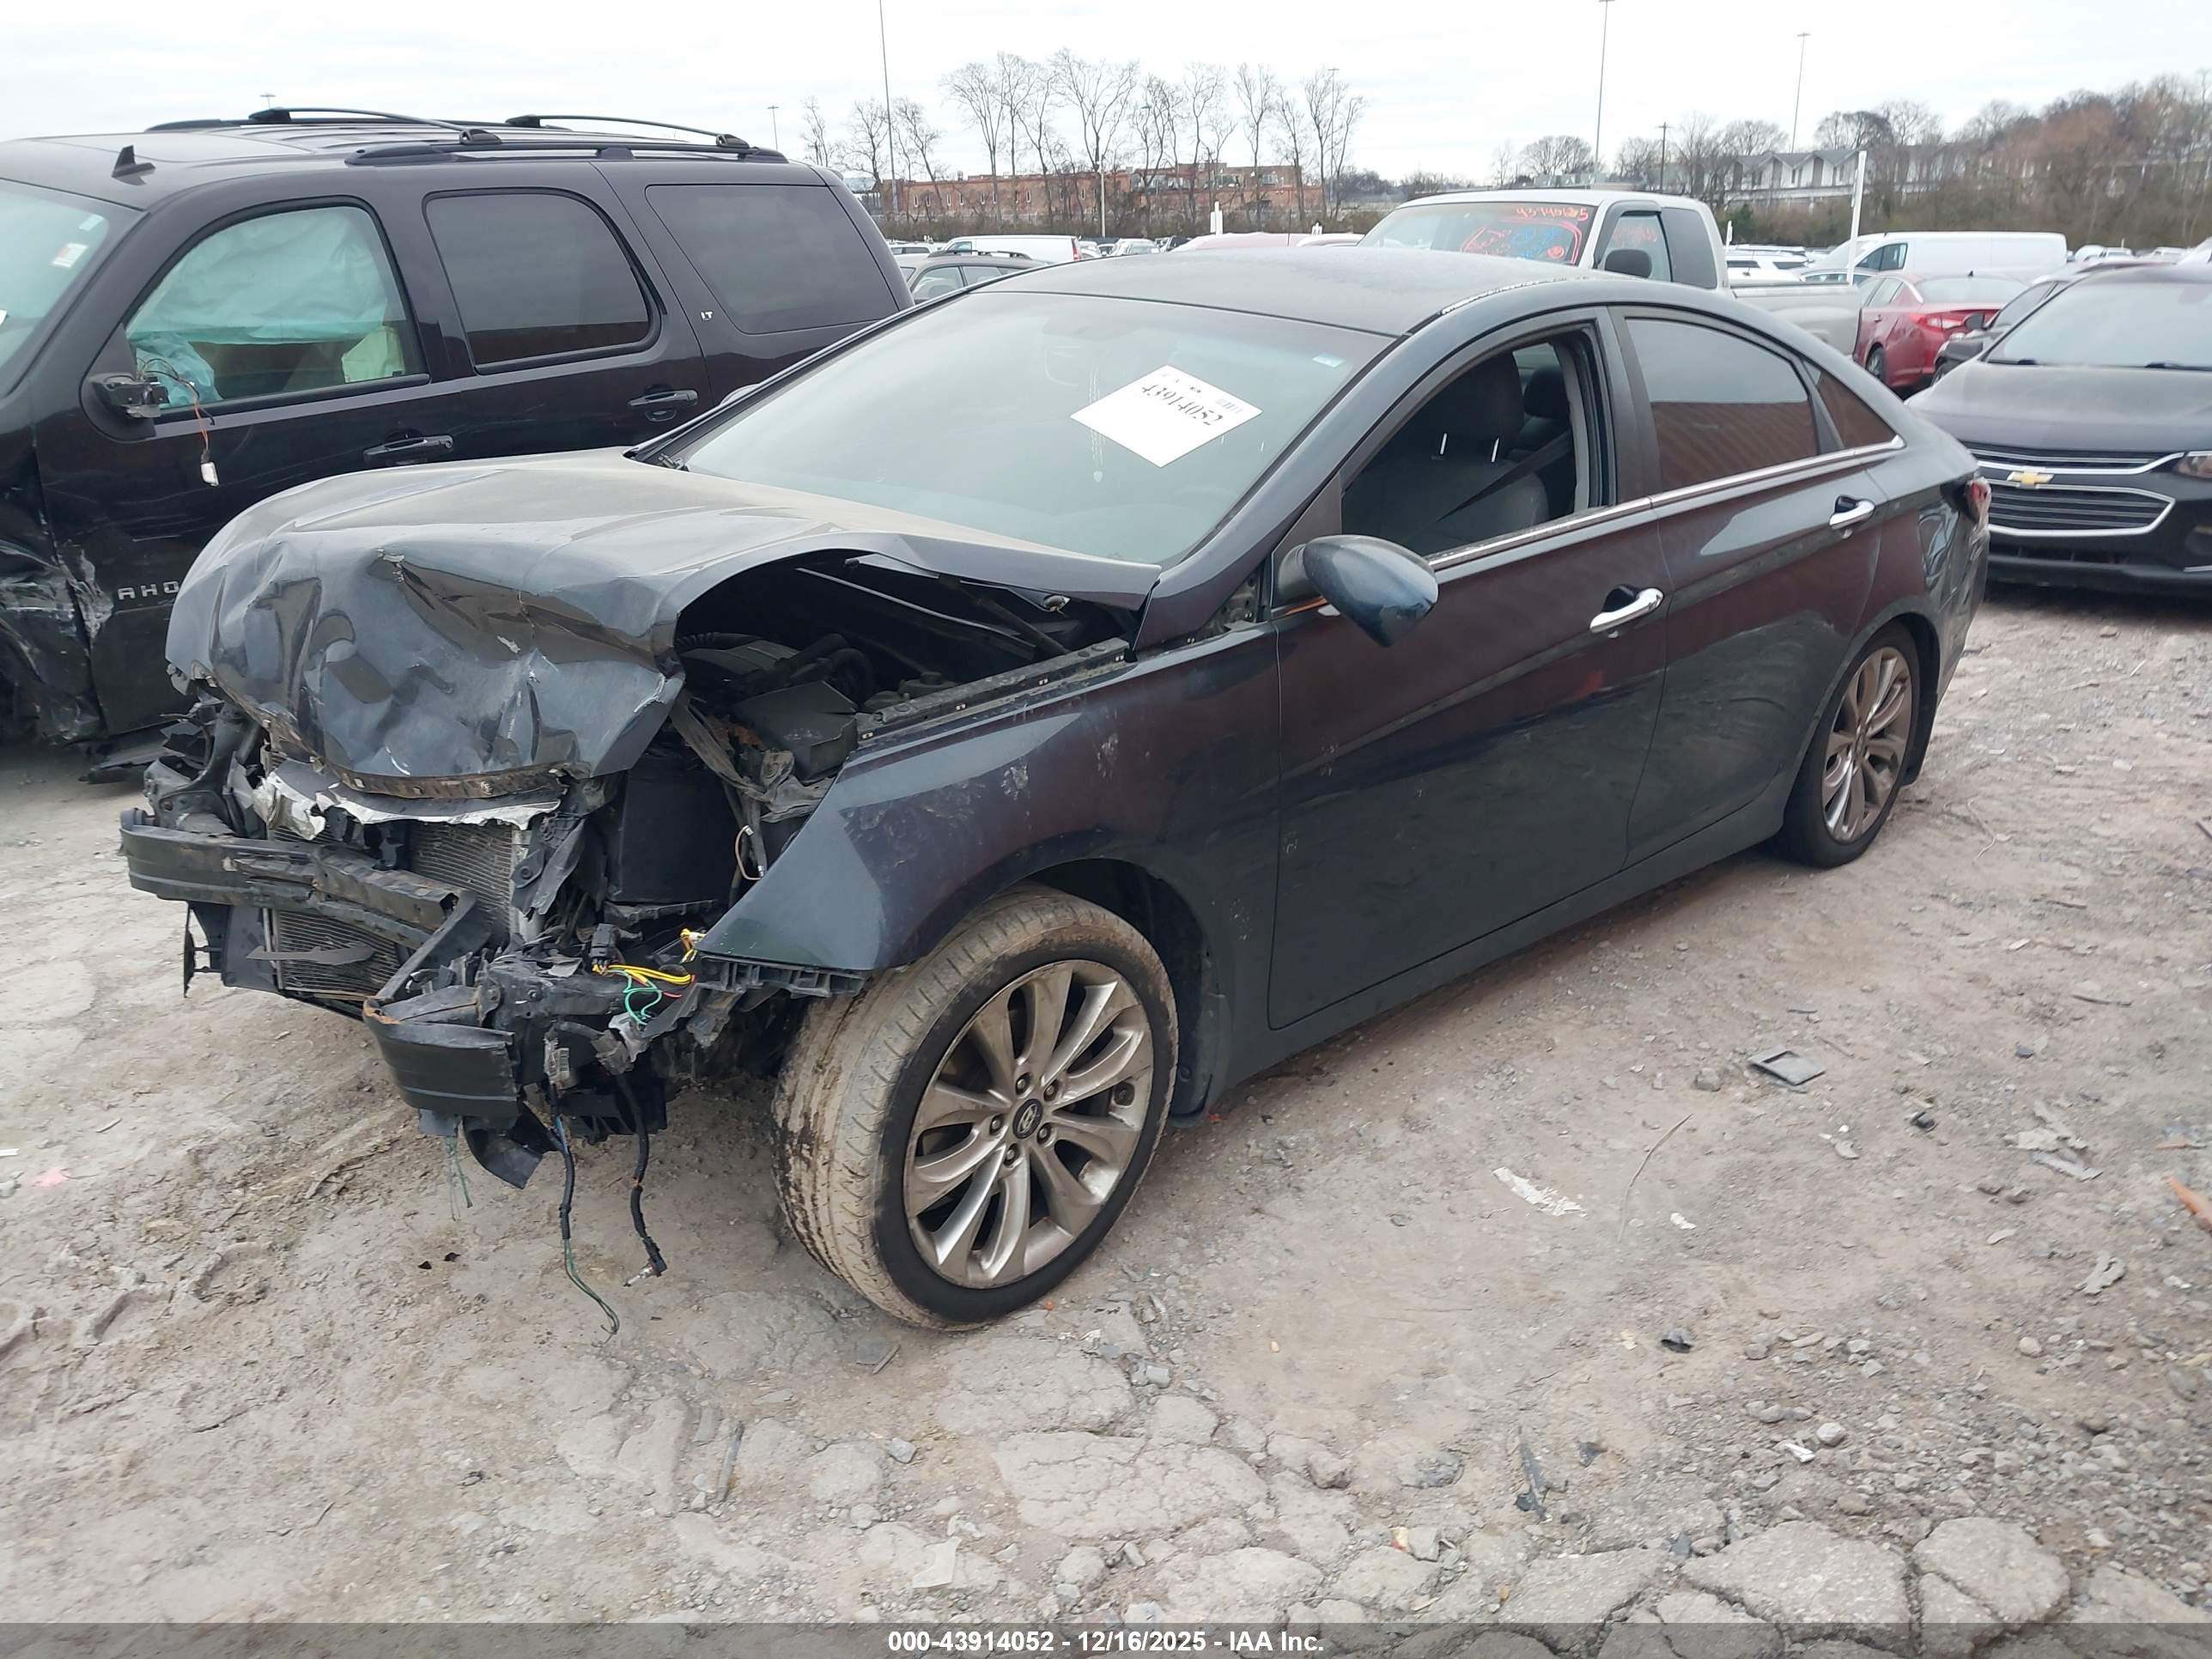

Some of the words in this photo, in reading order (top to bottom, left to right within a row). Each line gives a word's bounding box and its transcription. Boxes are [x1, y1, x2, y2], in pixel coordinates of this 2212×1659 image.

[701, 311, 714, 321] LT
[1141, 384, 1223, 426] 43914052
[117, 580, 179, 600] AHO
